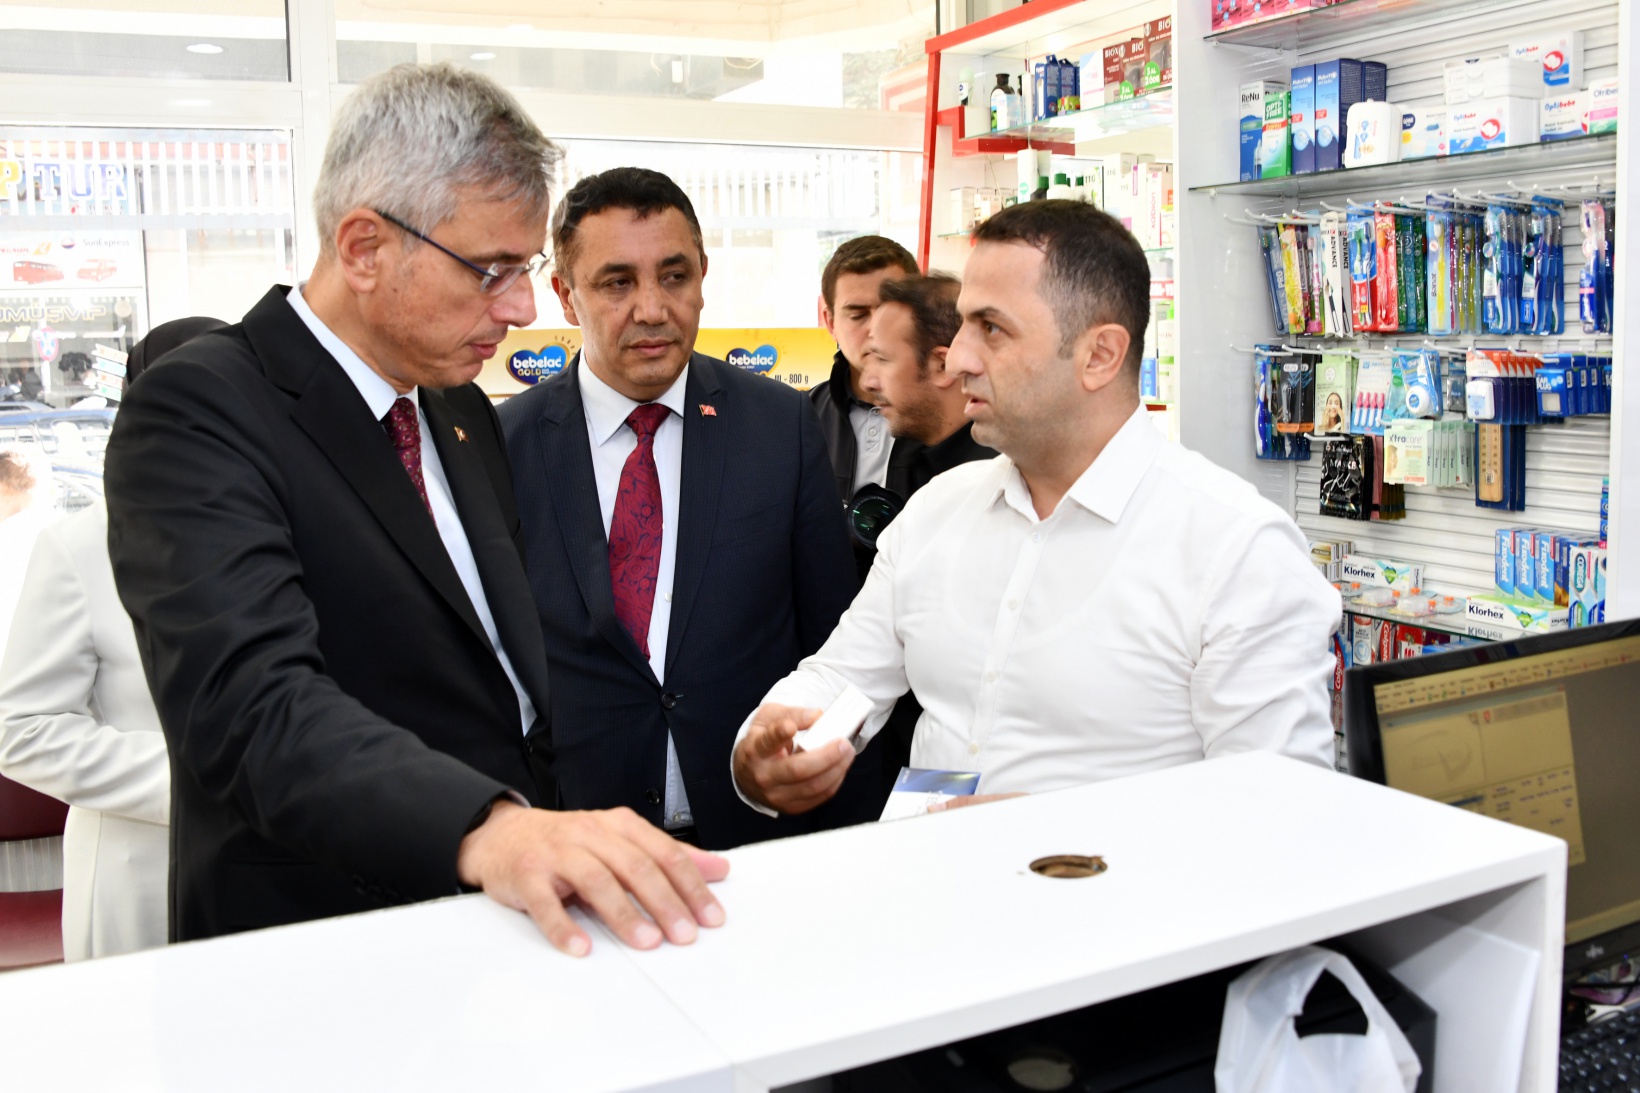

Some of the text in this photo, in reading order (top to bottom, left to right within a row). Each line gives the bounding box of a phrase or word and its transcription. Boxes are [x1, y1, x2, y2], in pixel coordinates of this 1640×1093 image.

[1241, 91, 1260, 104] ReNu
[1544, 100, 1576, 111] Optibebe
[33, 162, 127, 199] TUR
[1275, 270, 1285, 289] PRO
[512, 355, 562, 369] bebelac
[728, 353, 774, 366] bebelac
[517, 368, 541, 377] GOLD
[788, 373, 802, 384] 800
[804, 375, 809, 385] g
[1501, 536, 1509, 583] Fixodent
[1521, 537, 1530, 586] Fixodent
[1540, 540, 1550, 589] Fixodent
[1344, 565, 1376, 580] Klorhex
[1576, 556, 1585, 589] COREGA
[1468, 604, 1504, 620] Klorhex
[1334, 650, 1343, 690] Colgate
